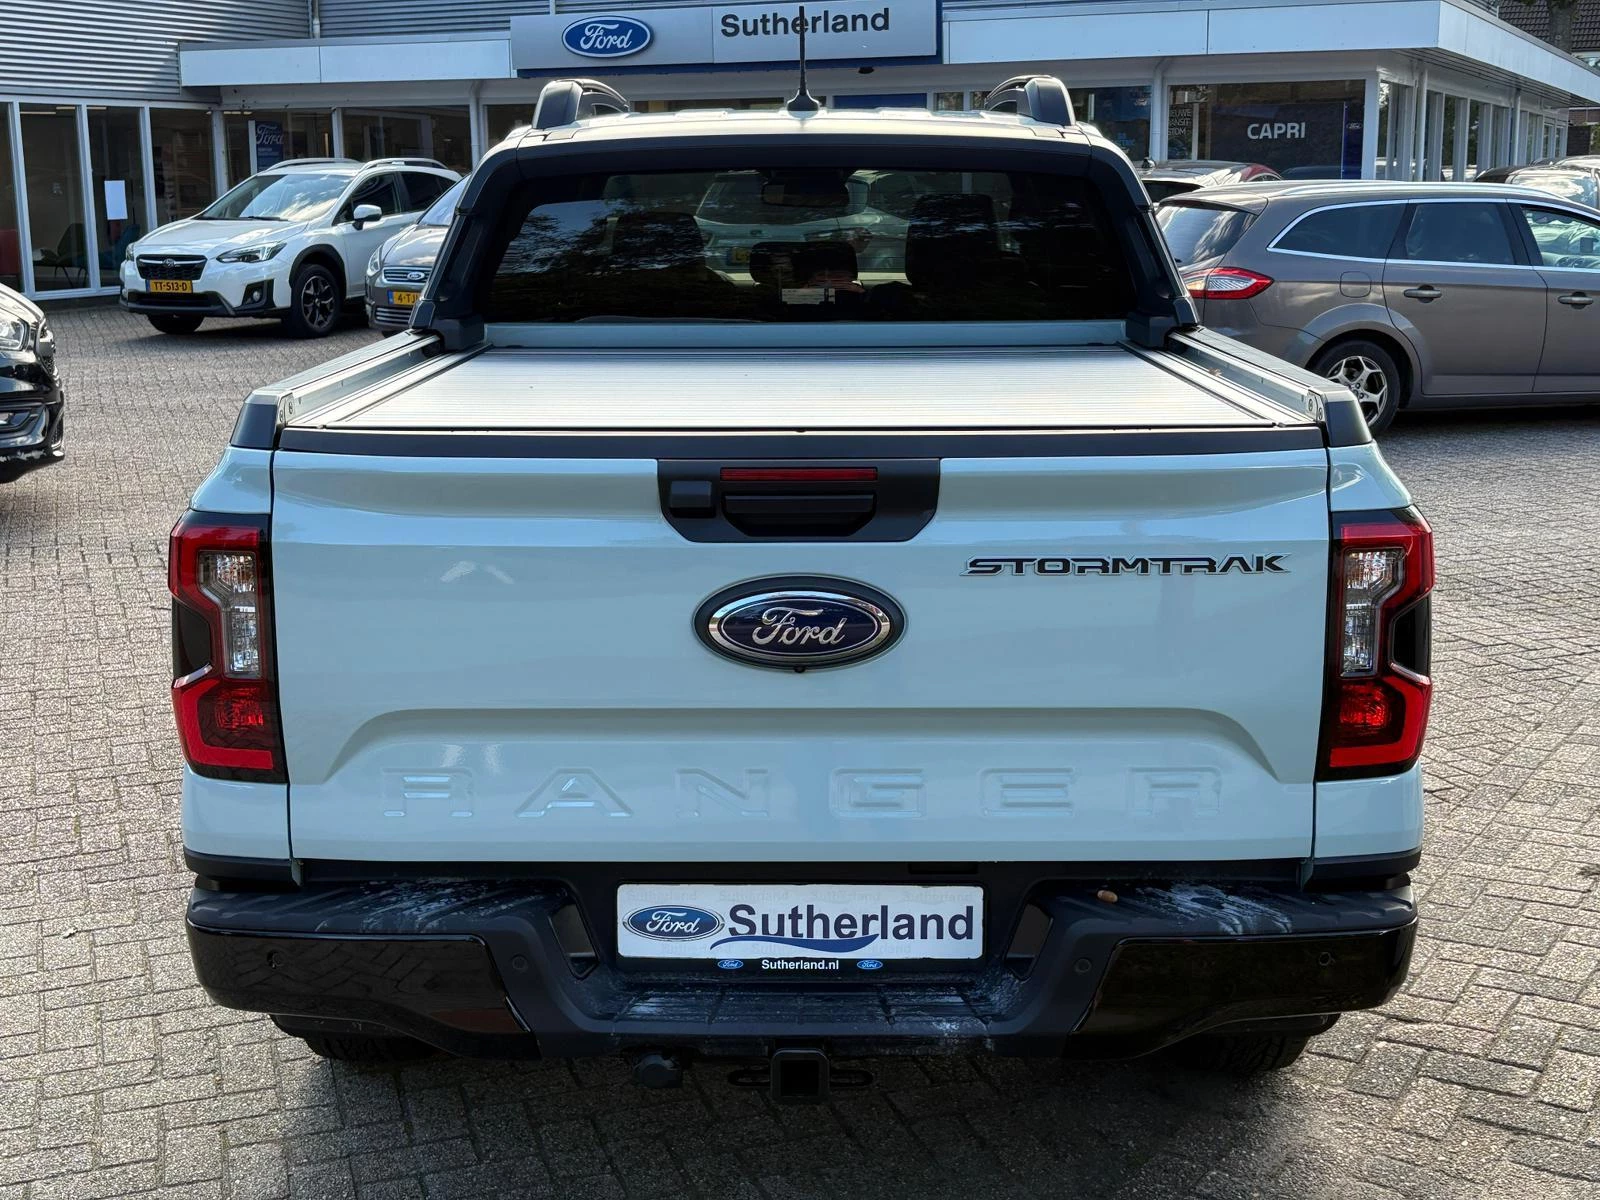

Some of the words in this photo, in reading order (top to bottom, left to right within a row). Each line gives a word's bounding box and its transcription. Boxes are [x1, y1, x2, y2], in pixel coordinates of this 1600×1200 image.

[580, 23, 633, 50] Ford
[720, 7, 890, 38] Sutherland
[1247, 122, 1306, 140] CAPRI
[153, 281, 188, 292] TT-513-D
[961, 553, 1291, 577] STORMTRAK
[752, 606, 848, 645] Ford
[381, 766, 1222, 819] RANGER
[645, 910, 701, 933] Ford
[728, 904, 974, 941] Sutherland
[761, 959, 839, 970] Sutherland.nl
